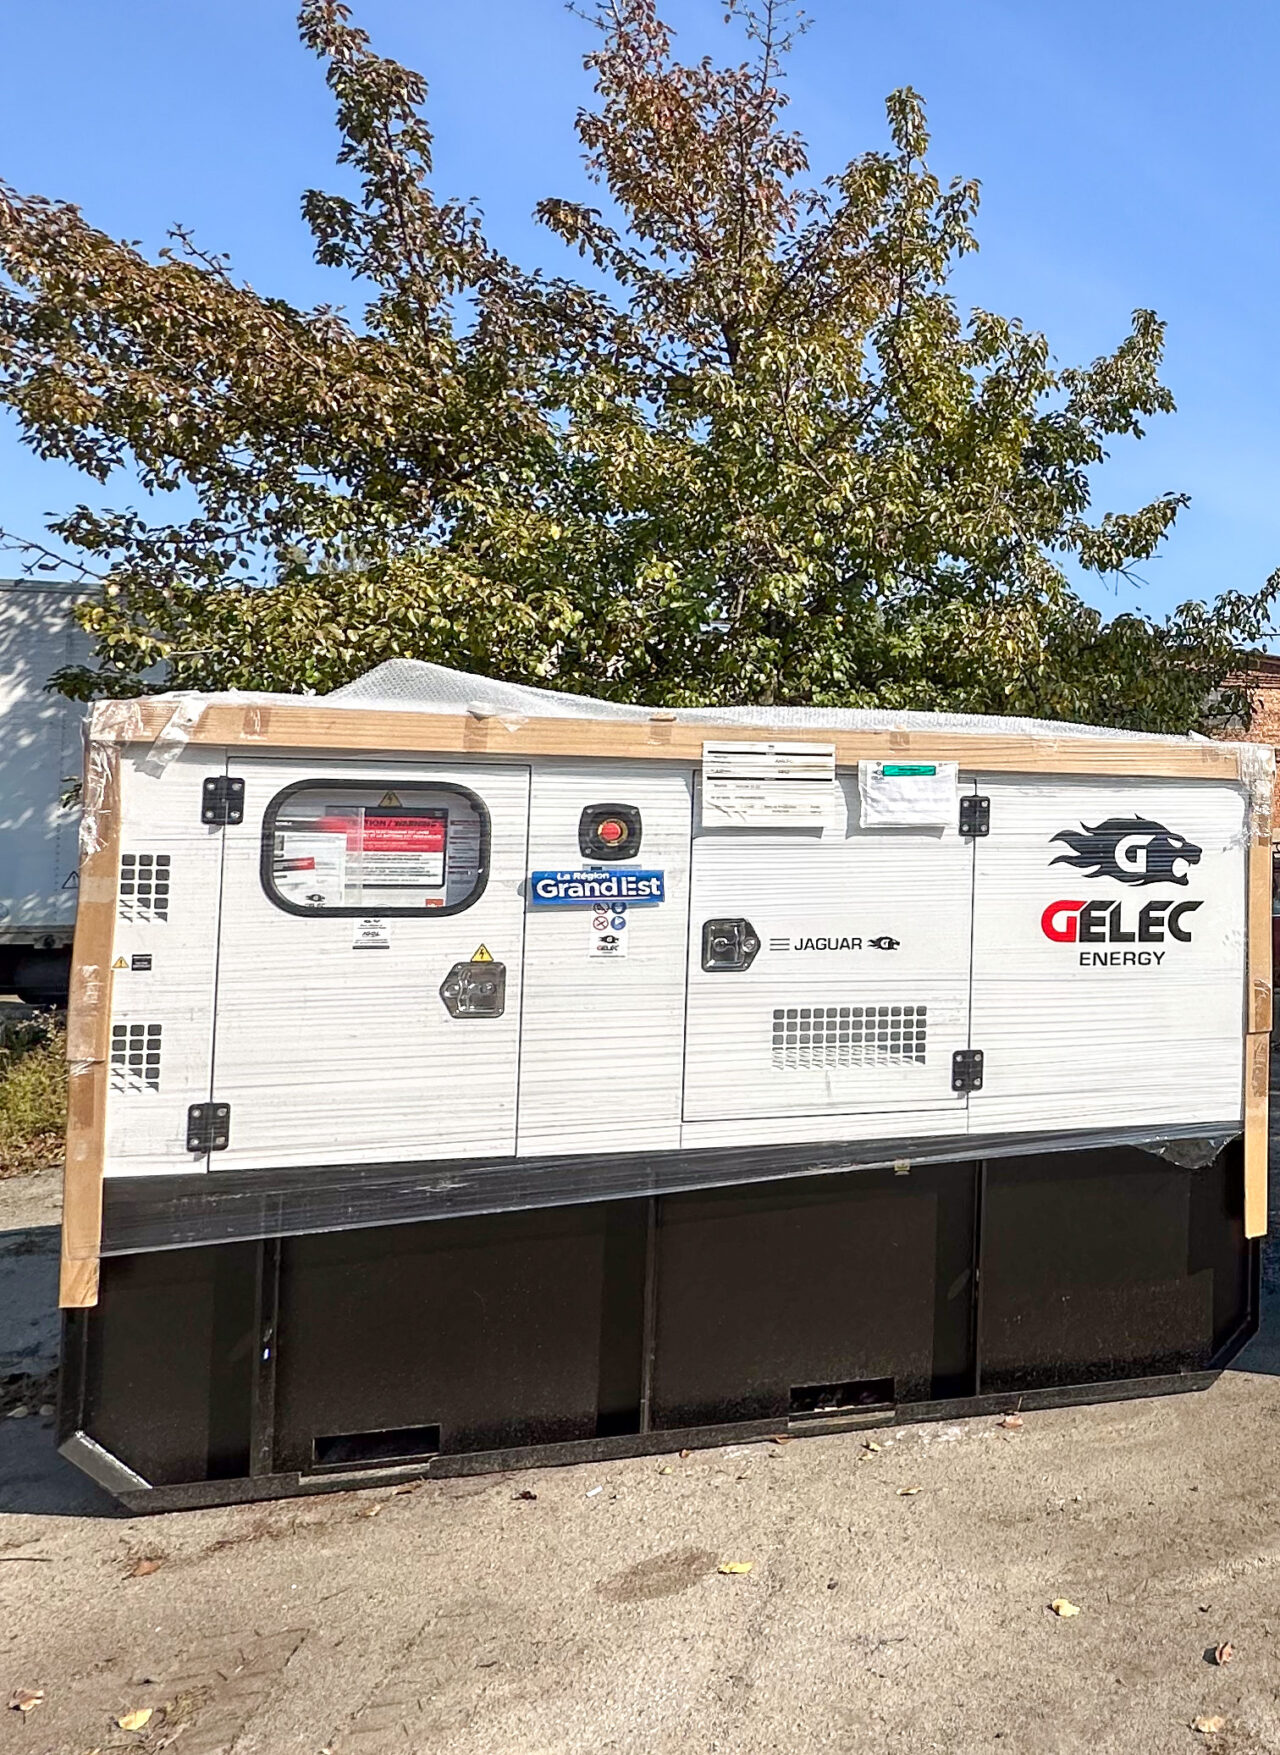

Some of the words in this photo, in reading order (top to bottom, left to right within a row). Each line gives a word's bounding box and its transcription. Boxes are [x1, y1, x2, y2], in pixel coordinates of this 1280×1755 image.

[557, 872, 571, 881] La
[573, 872, 610, 882] Région
[1041, 900, 1204, 943] GELEC
[794, 937, 862, 951] JAGUAR
[1079, 951, 1166, 966] ENERGY
